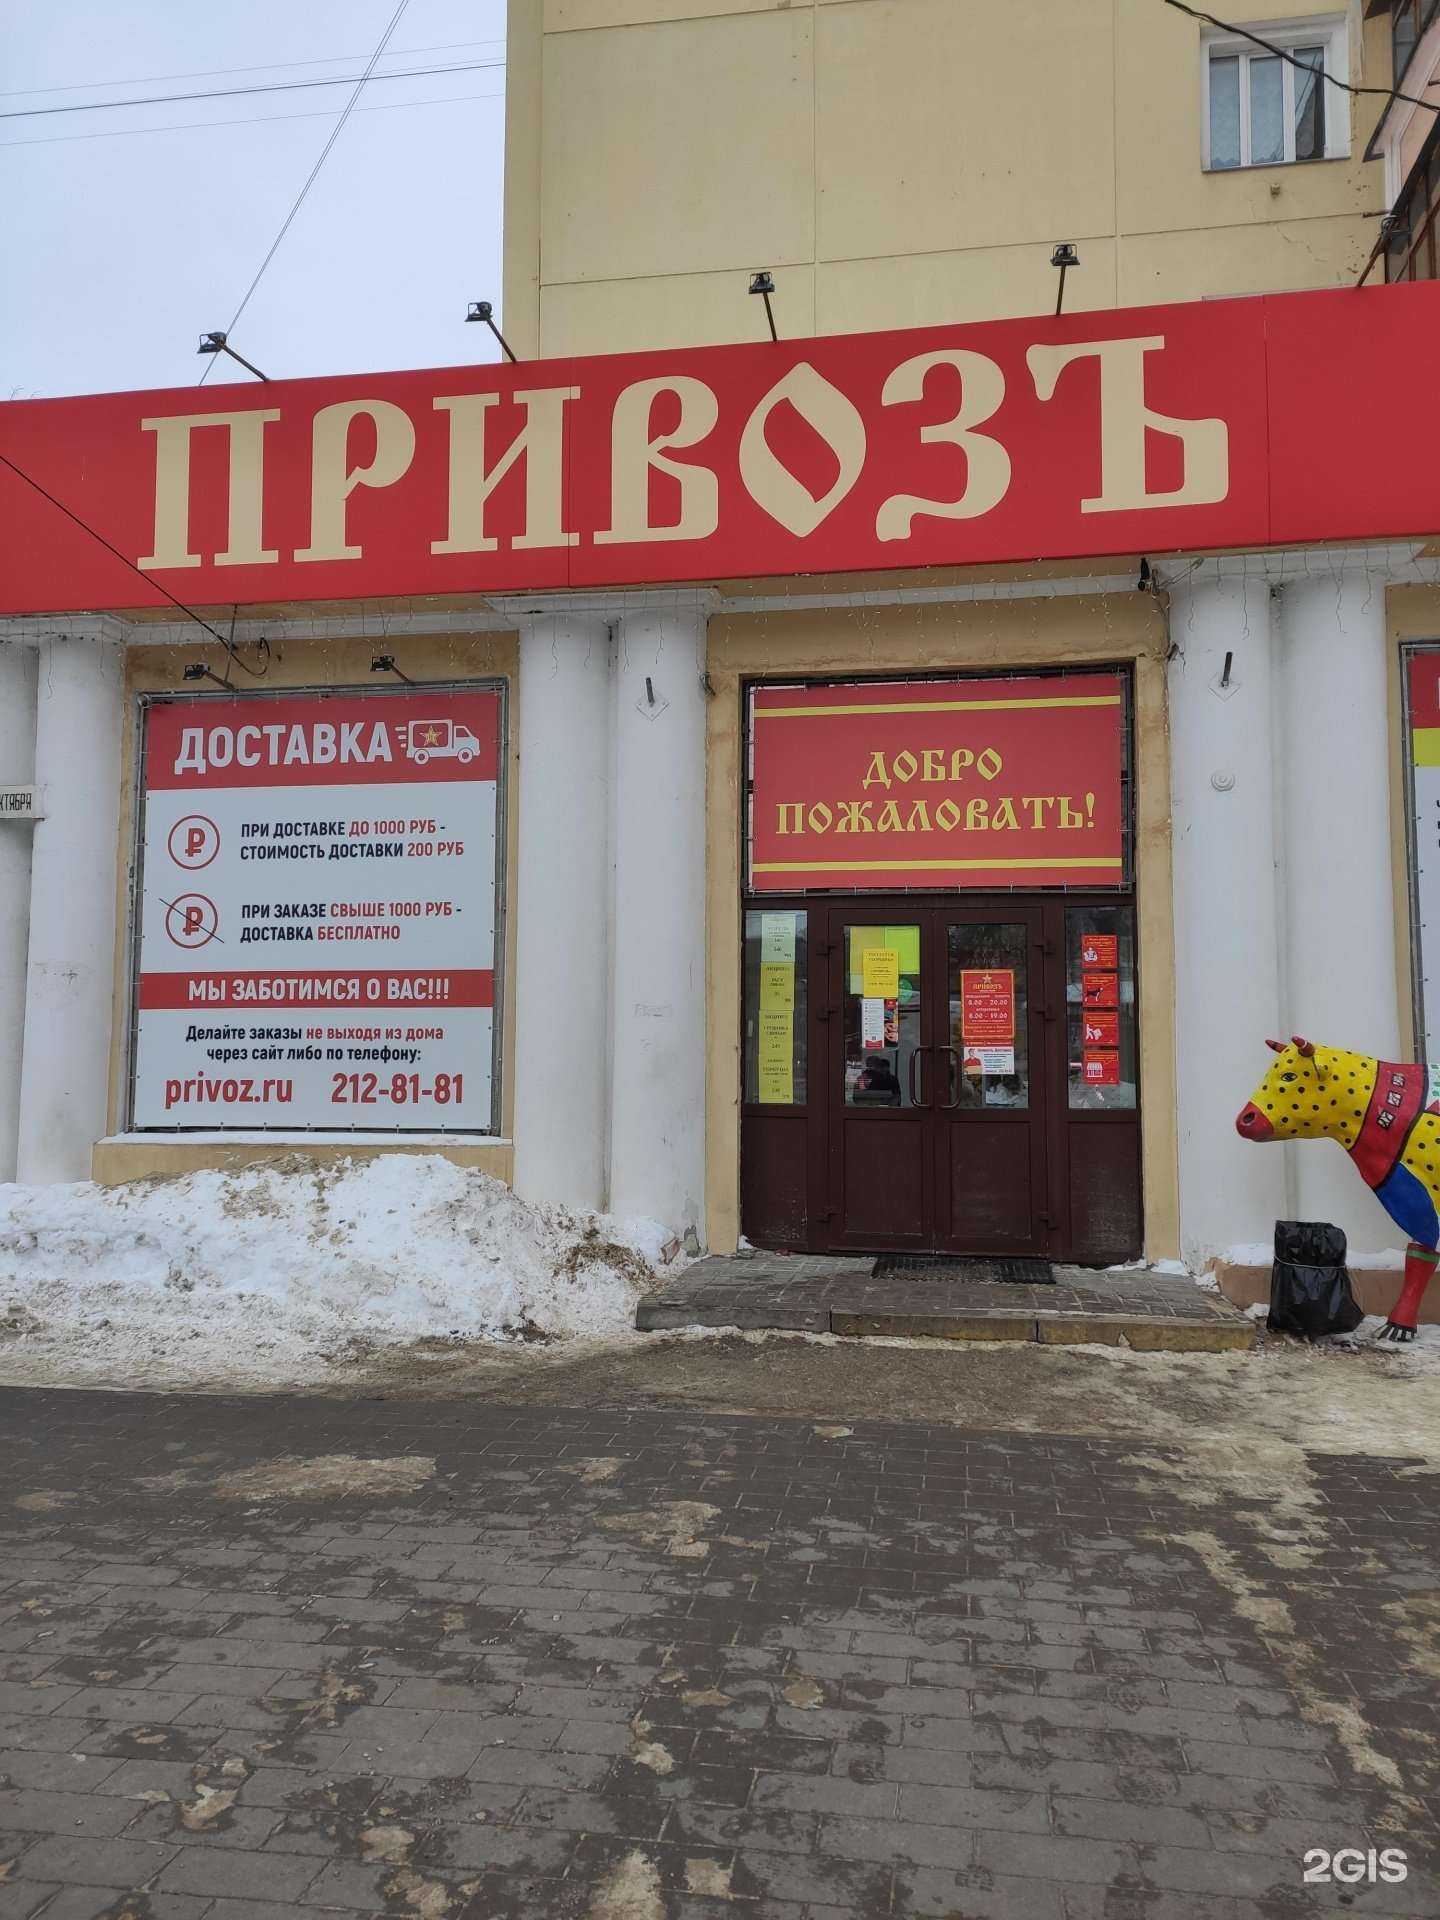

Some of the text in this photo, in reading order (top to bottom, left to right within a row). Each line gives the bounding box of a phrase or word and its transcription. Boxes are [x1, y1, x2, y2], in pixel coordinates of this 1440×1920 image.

[137, 334, 1228, 571] ПРИВОЗЪ
[175, 721, 393, 775] ДОСТАВКА
[862, 747, 1003, 790] ДОБРО
[775, 791, 1096, 835] ПОЖАЛОВАТЬ!
[242, 824, 269, 837] ПРИ
[273, 822, 345, 839] ДОСТАВКЕ
[349, 821, 369, 837] ДО
[374, 820, 405, 834] 1000
[410, 820, 436, 833] РУБ
[241, 842, 464, 860] СТОИМОСТЬ ДОСТАВКИ 200 РУБ
[242, 905, 269, 918] ПРИ
[274, 904, 326, 918] ЗАКАЗЕ
[331, 903, 384, 917] СВЫШЕ
[389, 903, 421, 916] 1000
[426, 902, 452, 916] РУБ
[240, 926, 400, 943] ДОСТАВКА БЕСПЛАТНО
[188, 978, 448, 1000] МЫ ЗАБОТИМСЯ О ВАС!!!
[186, 1025, 443, 1042] Делайте заказы не выходя из дома
[207, 1045, 421, 1064] через сайт либо по телефону:
[166, 1071, 292, 1109] privoz.ru
[332, 1073, 462, 1104] 212-81-81
